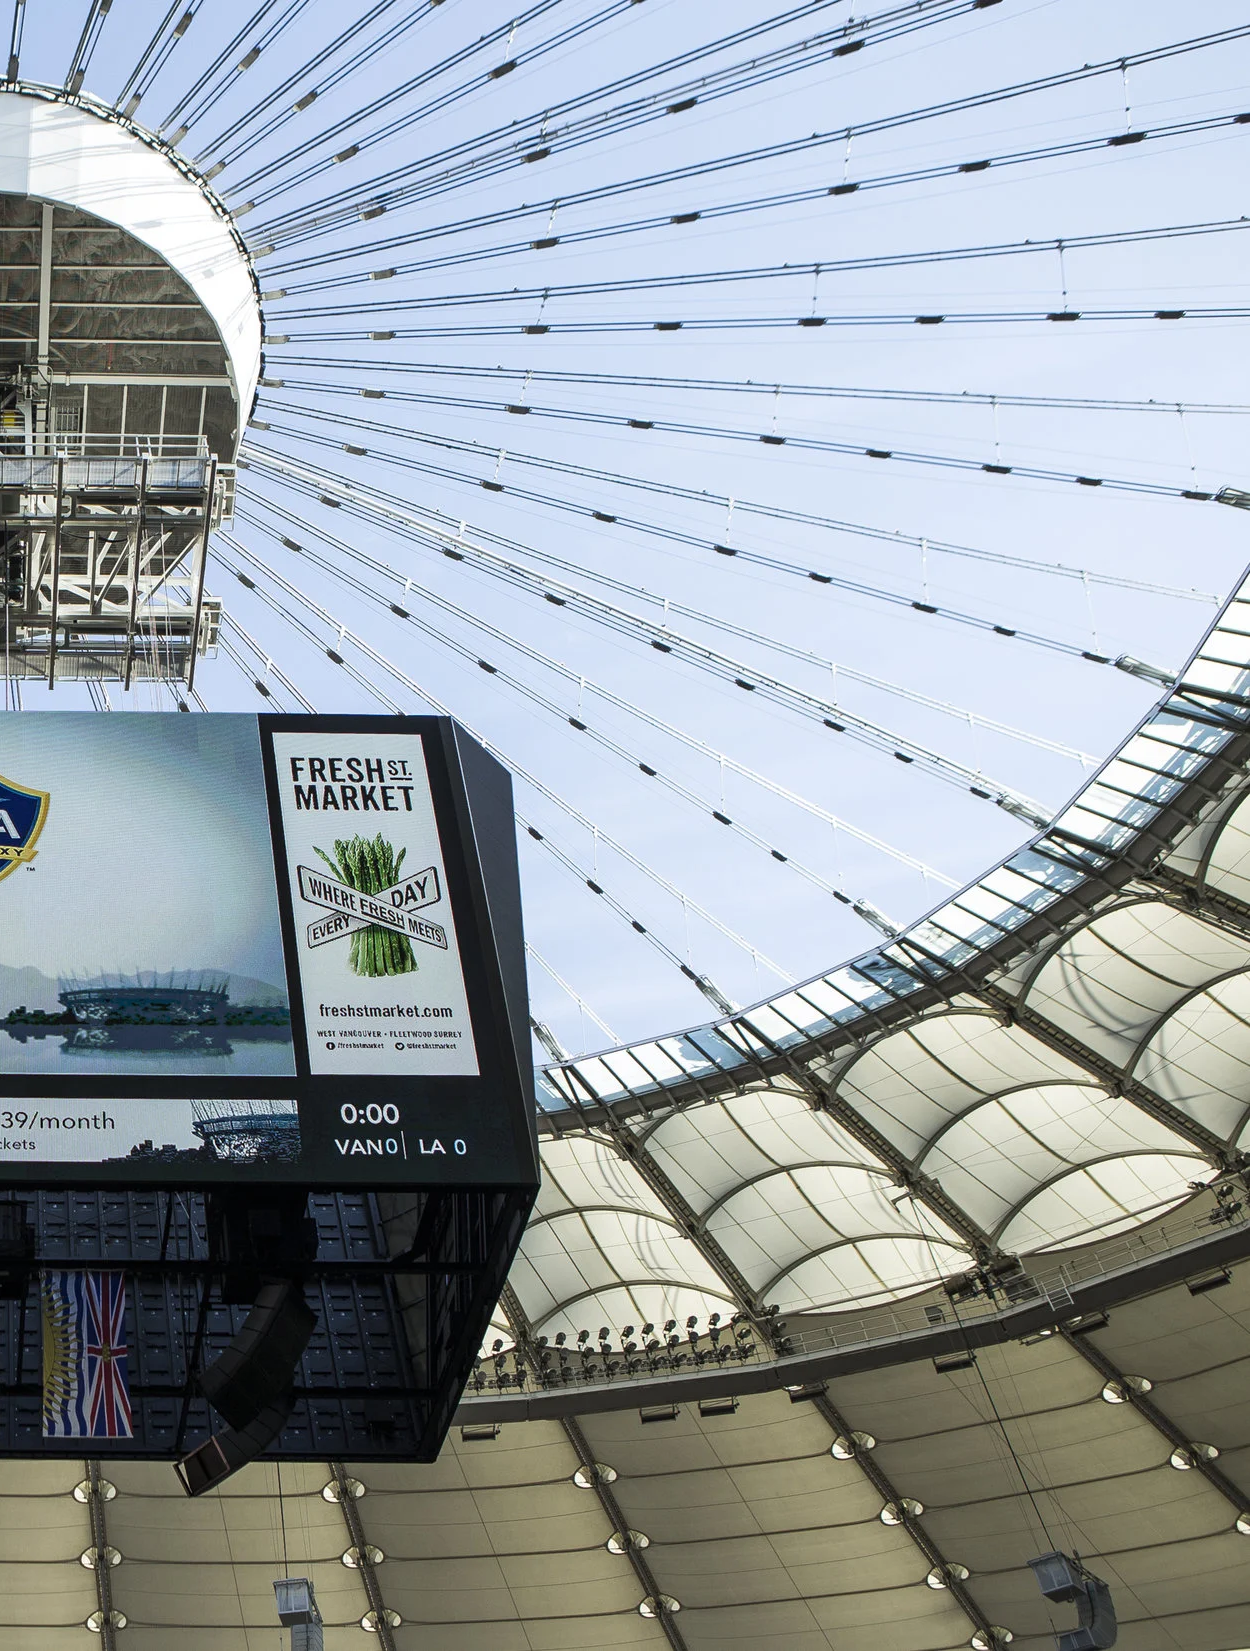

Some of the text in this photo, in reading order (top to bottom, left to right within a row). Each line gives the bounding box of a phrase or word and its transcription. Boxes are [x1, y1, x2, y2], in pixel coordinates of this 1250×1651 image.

[290, 757, 385, 783] FRESH
[294, 785, 414, 812] MARKET
[308, 876, 442, 943] WHERE FRESH MEETS
[312, 876, 428, 940] EVERY DAY
[319, 1003, 453, 1018] freshstmarket.com
[340, 1103, 400, 1124] 0:00
[418, 1139, 446, 1154] LA
[453, 1138, 467, 1154] 0
